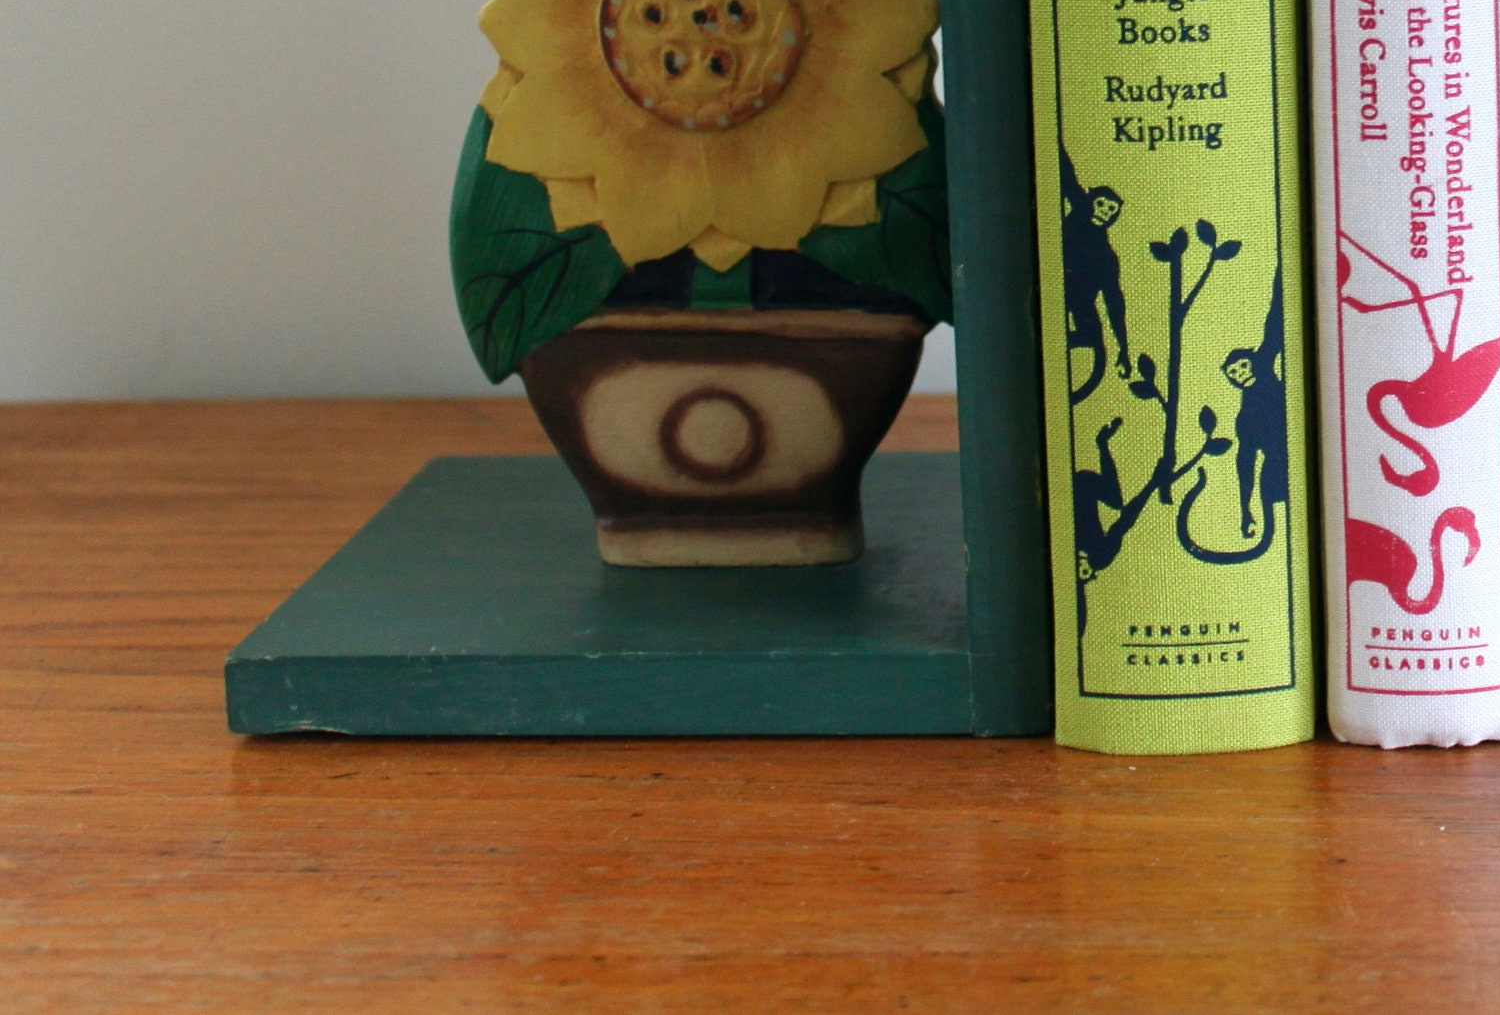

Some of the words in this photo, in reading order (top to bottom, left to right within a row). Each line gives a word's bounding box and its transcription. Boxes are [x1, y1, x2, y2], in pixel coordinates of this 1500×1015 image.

[1117, 17, 1211, 45] Books
[1406, 7, 1433, 49] the
[1104, 71, 1228, 110] Rudyard
[1358, 37, 1388, 142] Carroll
[1443, 71, 1470, 99] in
[1111, 116, 1223, 151] Kipling
[1399, 55, 1437, 260] Looking-Glass
[1444, 105, 1475, 285] Wonderland
[1128, 621, 1240, 637] PENGUIN
[1370, 625, 1481, 642] PENGUIN
[1126, 650, 1245, 666] CLASSICS
[1368, 655, 1485, 671] CLASSICS
